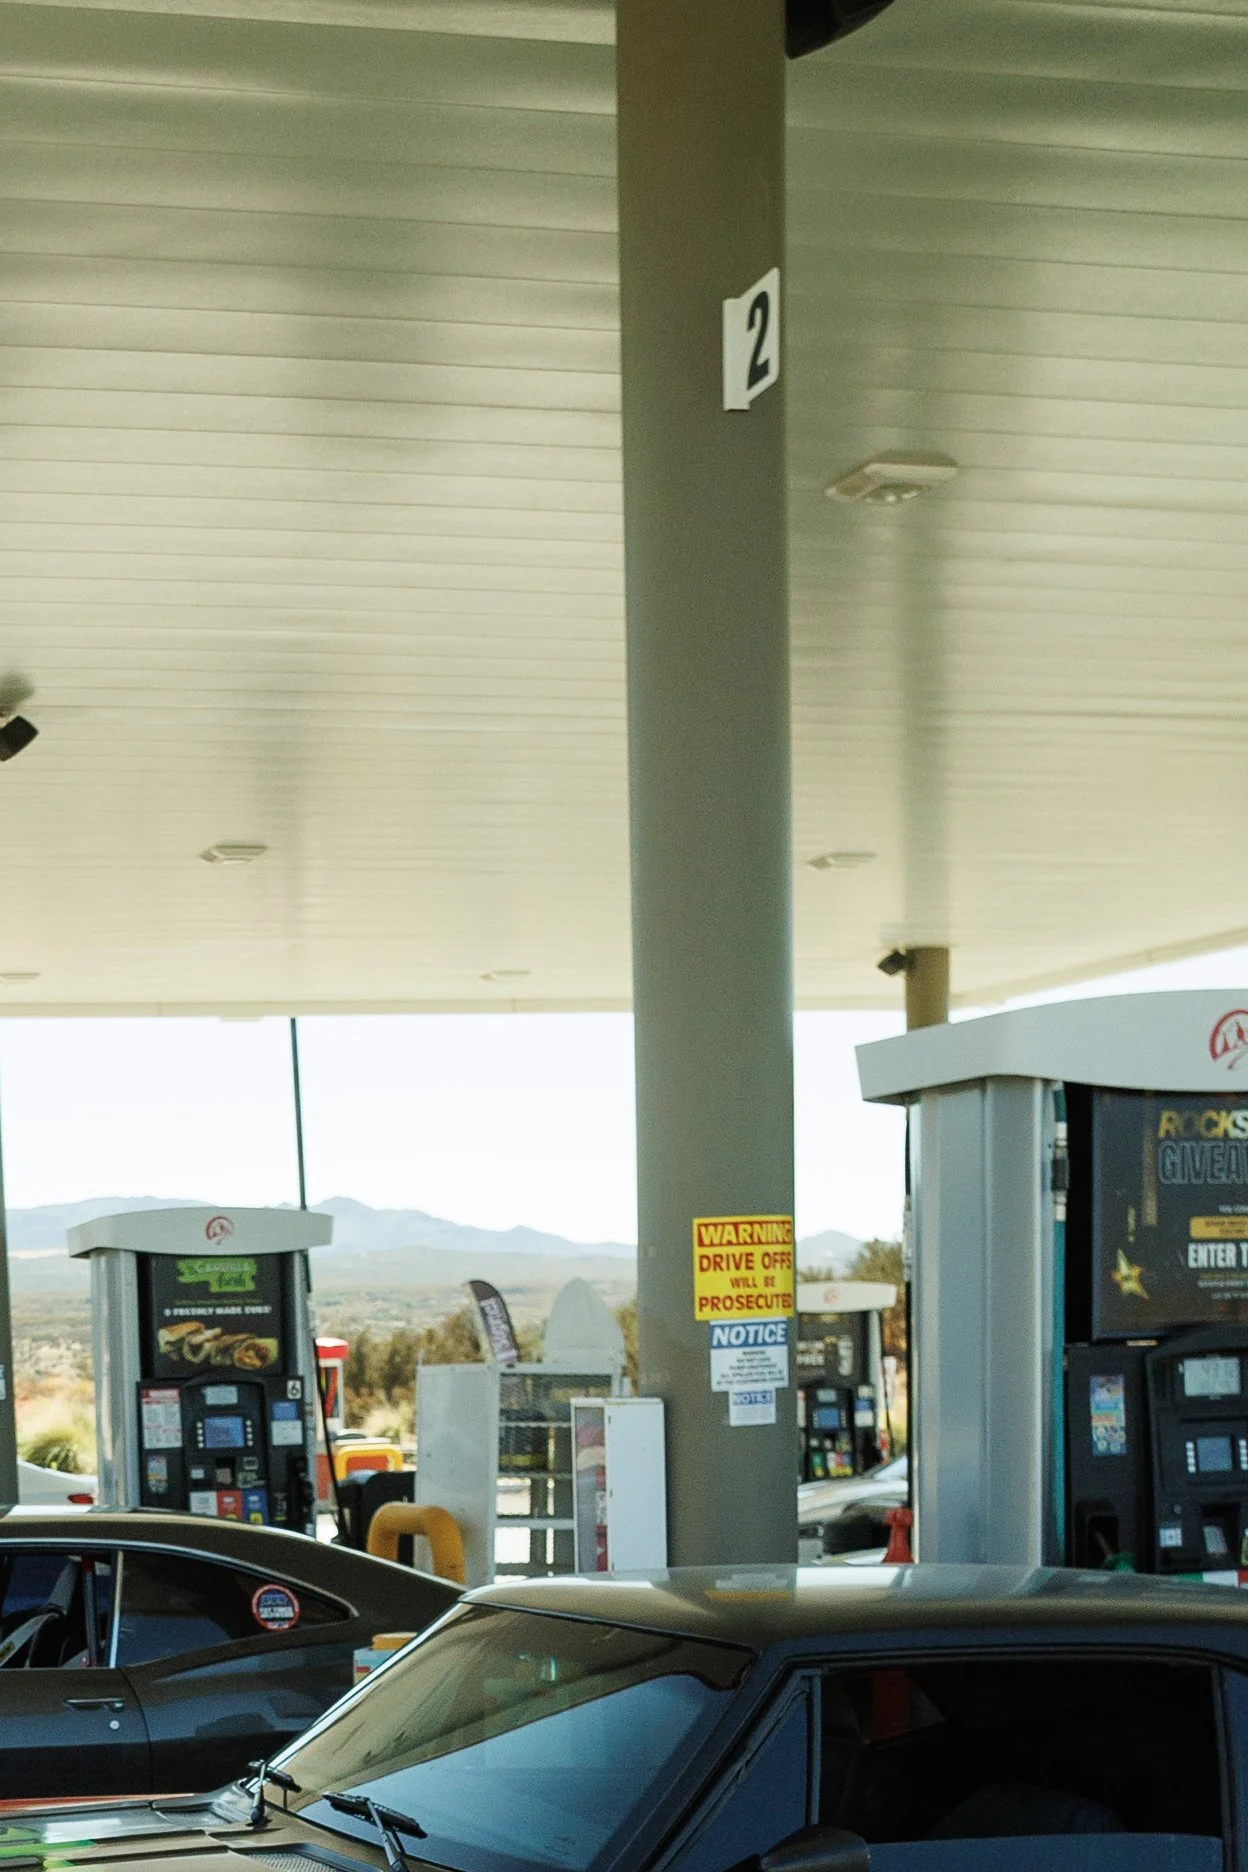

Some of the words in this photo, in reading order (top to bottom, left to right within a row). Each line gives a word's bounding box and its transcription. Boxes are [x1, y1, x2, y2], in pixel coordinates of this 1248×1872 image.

[747, 291, 769, 391] 2
[1157, 1140, 1248, 1184] GIVEA
[701, 1222, 792, 1246] WARNING
[699, 1253, 755, 1272] DRIVE
[762, 1252, 792, 1271] OFFS
[1188, 1242, 1236, 1268] ENTER
[730, 1276, 758, 1288] WILL
[764, 1276, 776, 1287] BE
[698, 1293, 792, 1312] PROSECUTED
[712, 1323, 787, 1348] NOTICE
